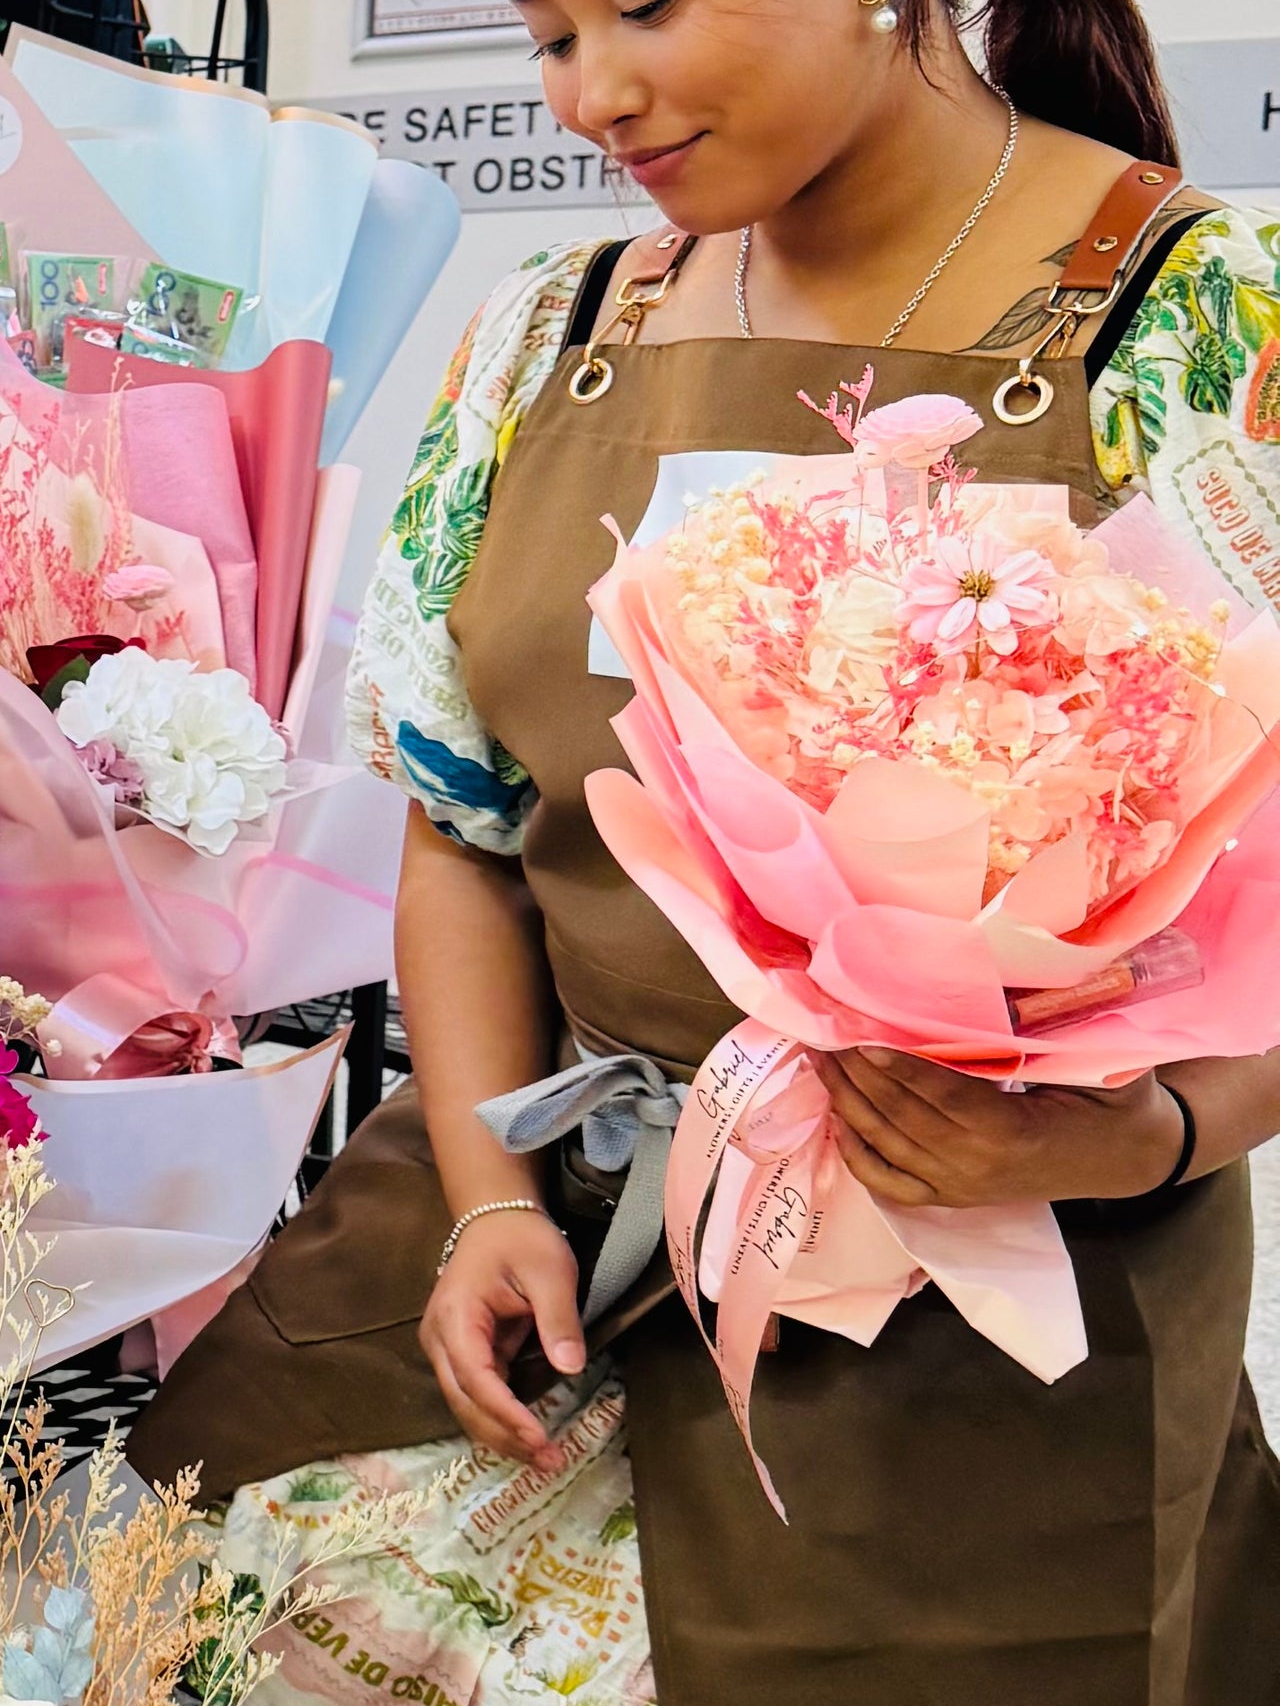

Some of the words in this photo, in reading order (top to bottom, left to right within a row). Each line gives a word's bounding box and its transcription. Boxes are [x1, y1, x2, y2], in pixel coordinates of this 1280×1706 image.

[403, 101, 562, 143] SAFET
[696, 1039, 754, 1120] Gabriel
[768, 1157, 791, 1198] OWERS
[751, 1186, 808, 1270] Gabriel
[344, 1648, 390, 1688] DE
